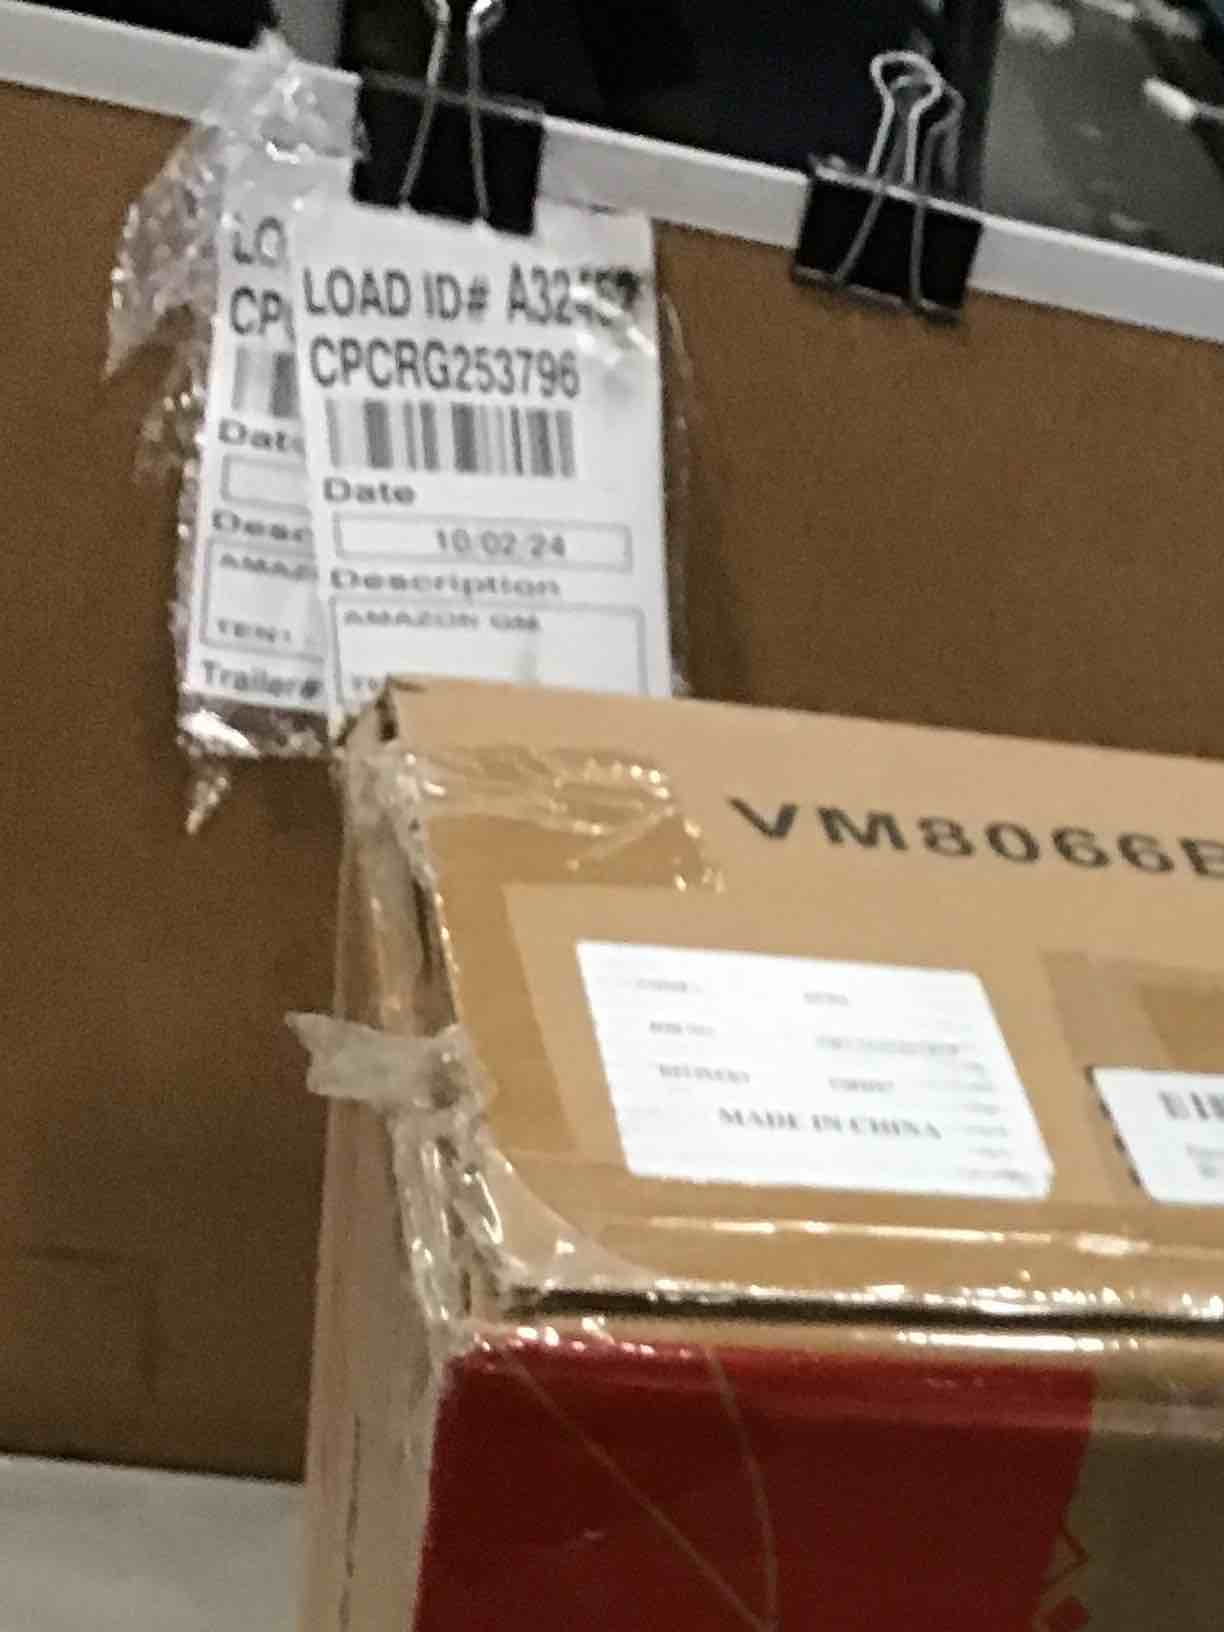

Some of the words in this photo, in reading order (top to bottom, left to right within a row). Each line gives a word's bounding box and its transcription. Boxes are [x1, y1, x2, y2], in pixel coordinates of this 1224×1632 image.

[302, 264, 410, 318] LOAD
[421, 268, 491, 323] ID#
[308, 335, 580, 398] CPCRG253796
[323, 476, 415, 505] Date
[329, 567, 561, 601] Description
[716, 1105, 802, 1132] MADE
[811, 1112, 844, 1135] IN
[848, 1115, 943, 1142] CHINA
